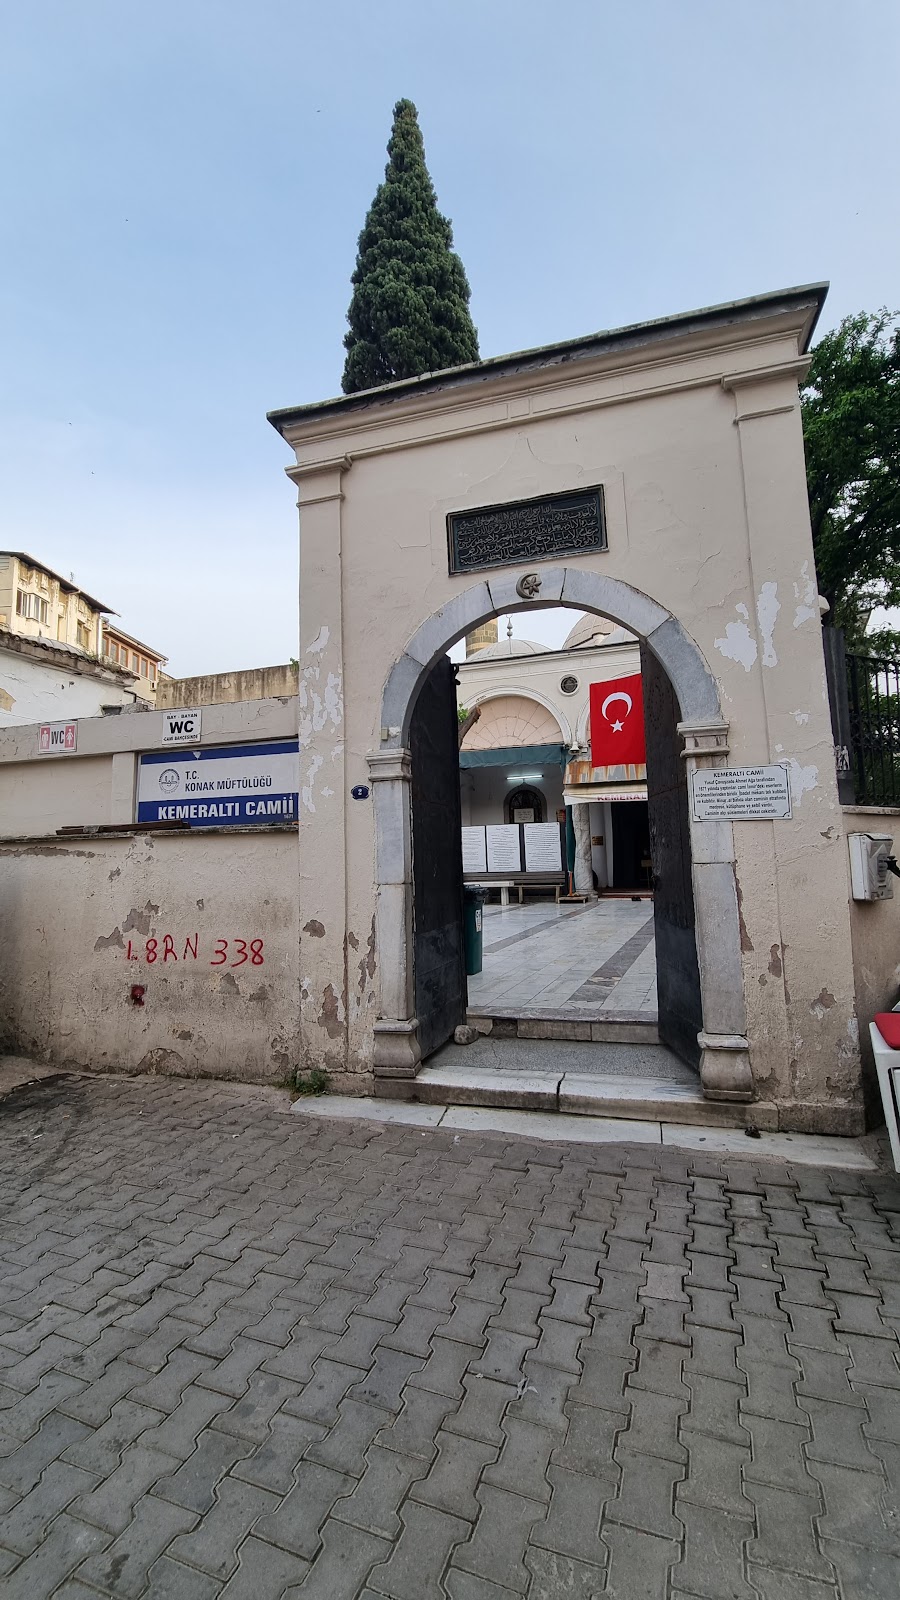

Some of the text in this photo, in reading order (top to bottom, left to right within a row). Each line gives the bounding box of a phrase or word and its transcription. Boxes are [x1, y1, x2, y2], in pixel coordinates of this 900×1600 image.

[169, 720, 194, 734] WC
[51, 731, 65, 744] WC
[185, 770, 200, 780] T.C.
[184, 781, 215, 792] KONAK
[217, 775, 272, 790] MÜFTÜLÜĞÜ
[158, 796, 294, 820] KEMERALTI CAMİİ
[210, 939, 264, 968] 338
